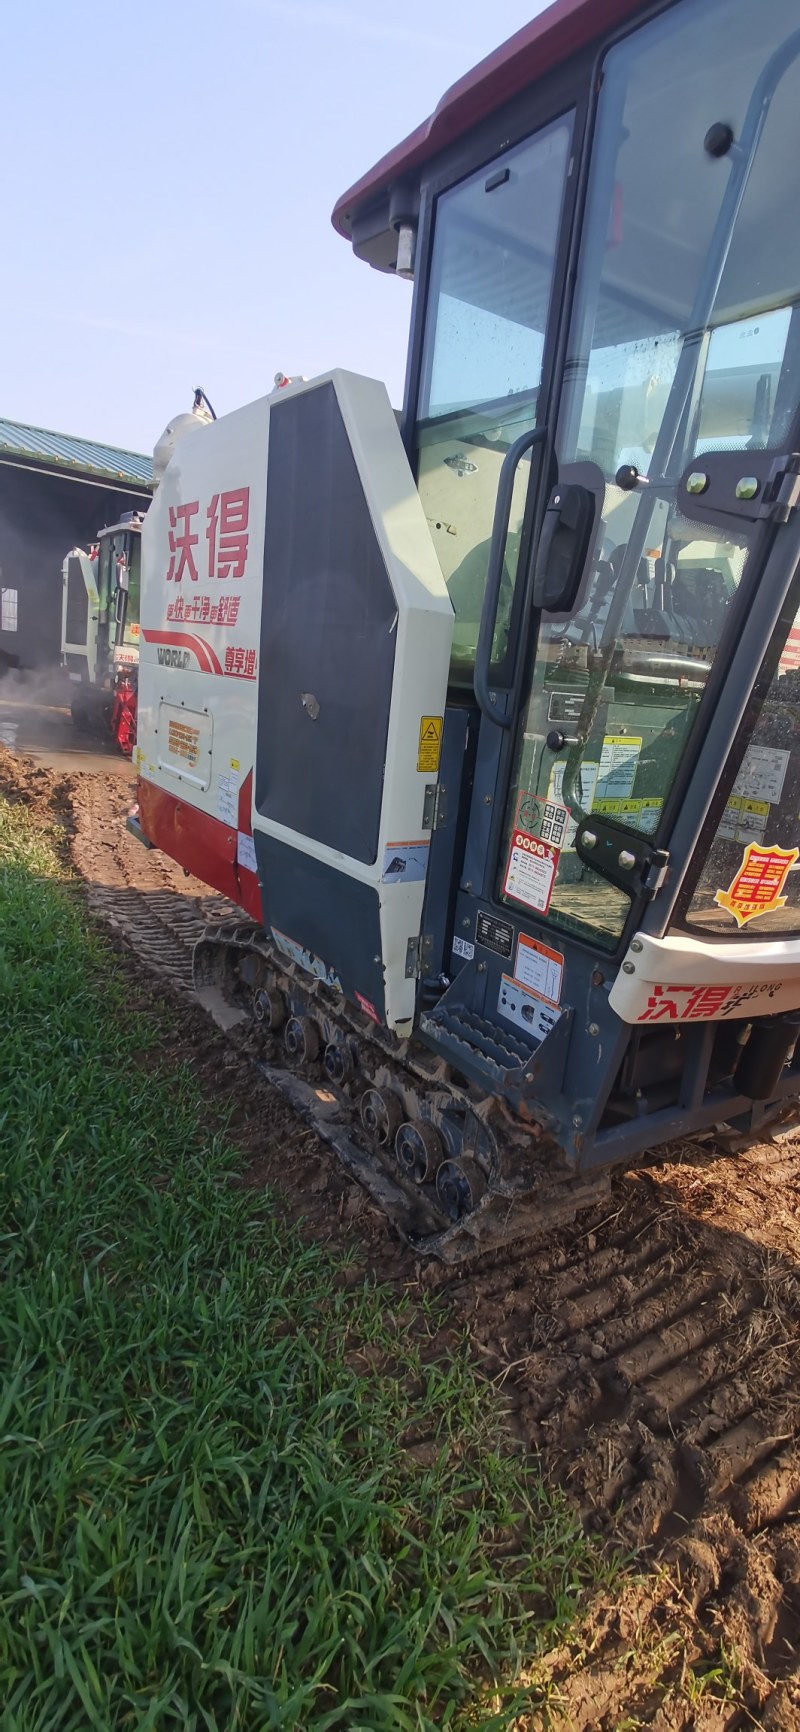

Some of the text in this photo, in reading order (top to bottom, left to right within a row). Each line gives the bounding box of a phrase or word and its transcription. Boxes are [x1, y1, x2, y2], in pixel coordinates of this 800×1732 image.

[166, 487, 250, 582] 沃得
[225, 647, 257, 675] 尊享增
[637, 985, 733, 1020] 沃得
